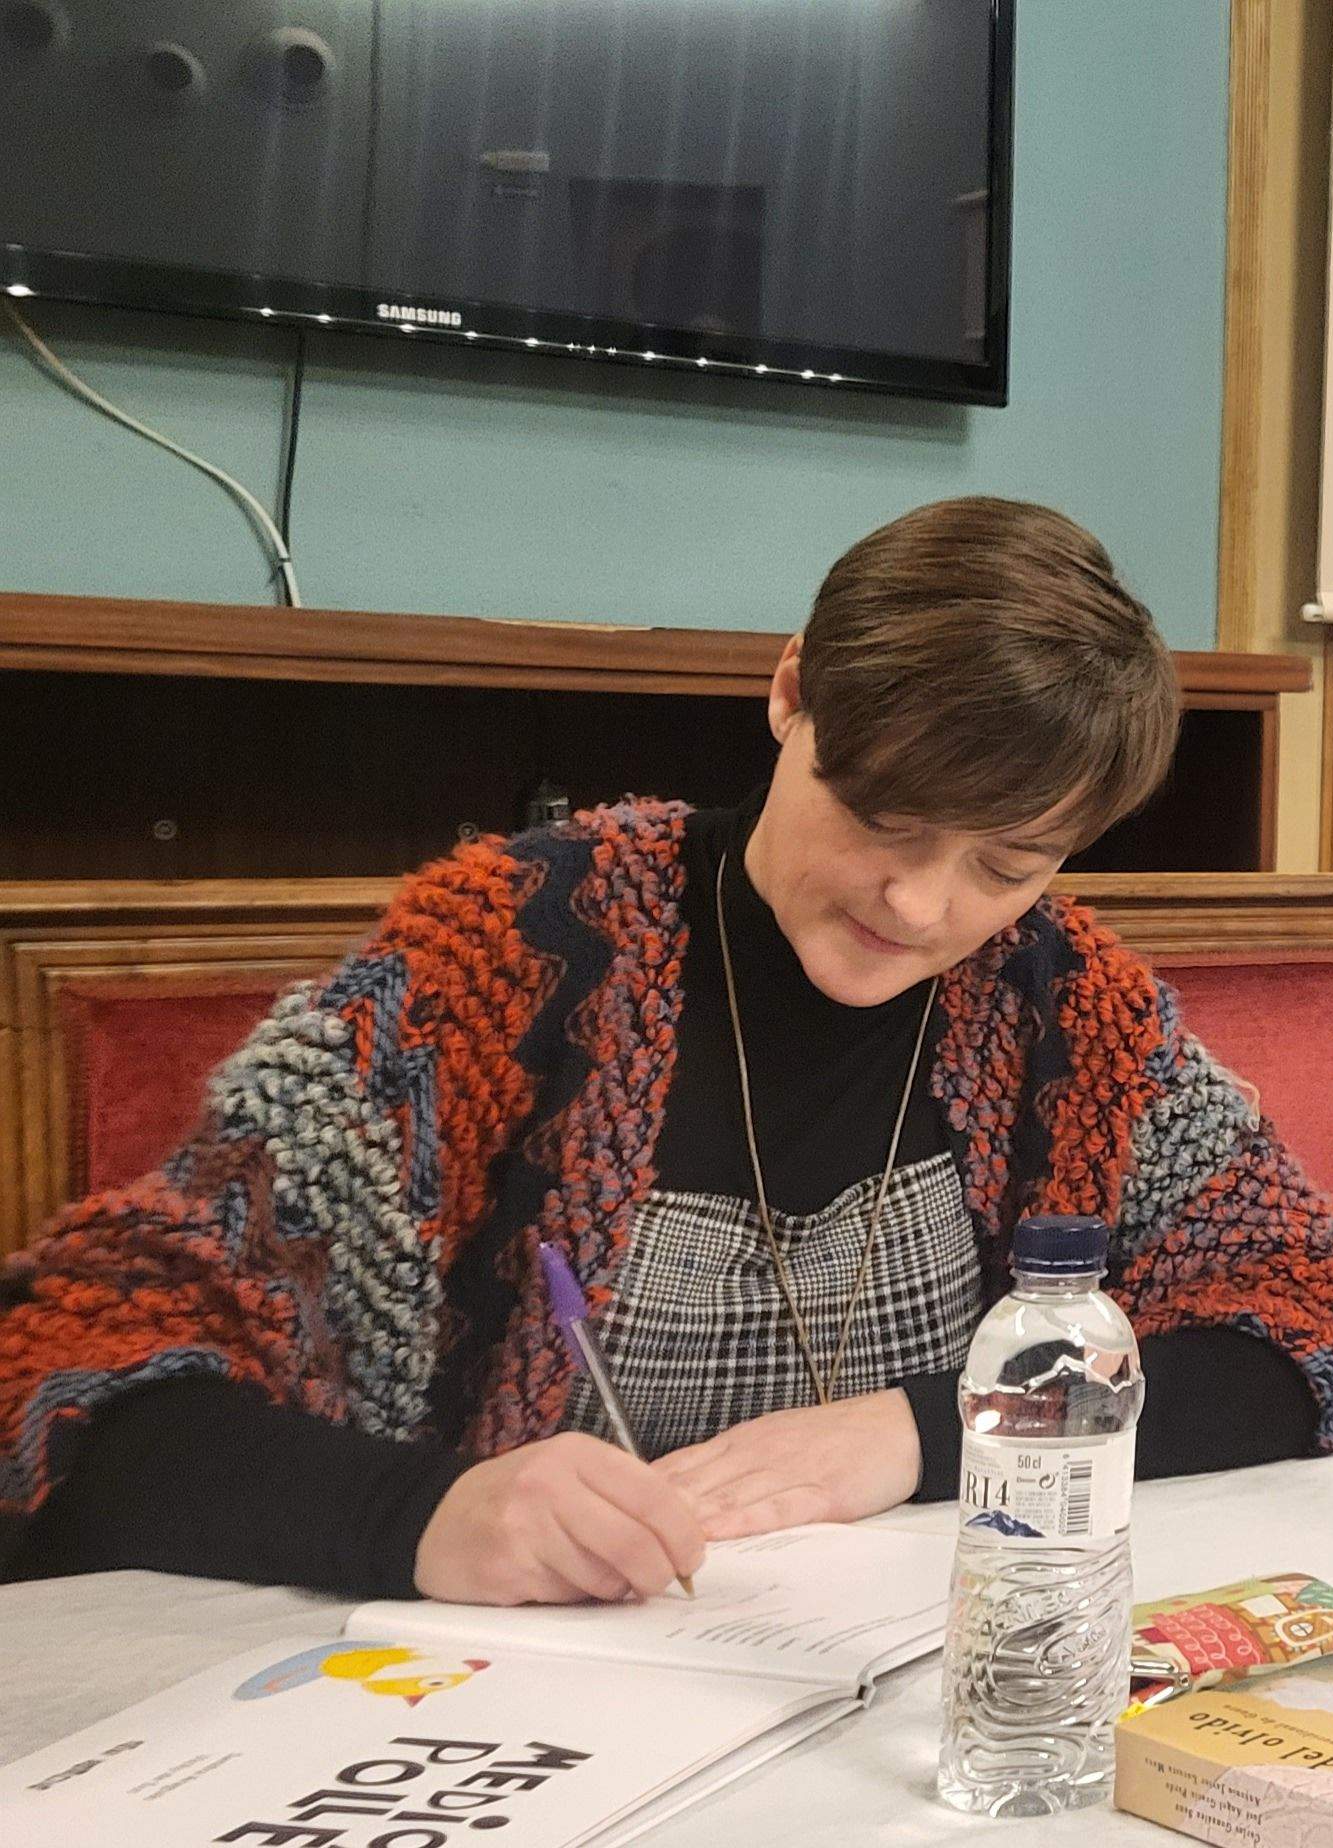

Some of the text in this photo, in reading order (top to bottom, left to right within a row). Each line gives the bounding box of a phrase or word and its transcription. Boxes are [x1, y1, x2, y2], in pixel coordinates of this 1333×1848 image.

[377, 303, 461, 326] SAMSUNG
[962, 1470, 1011, 1509] RI 4
[1190, 1711, 1284, 1747] olvido
[1233, 1825, 1262, 1848] Carlos
